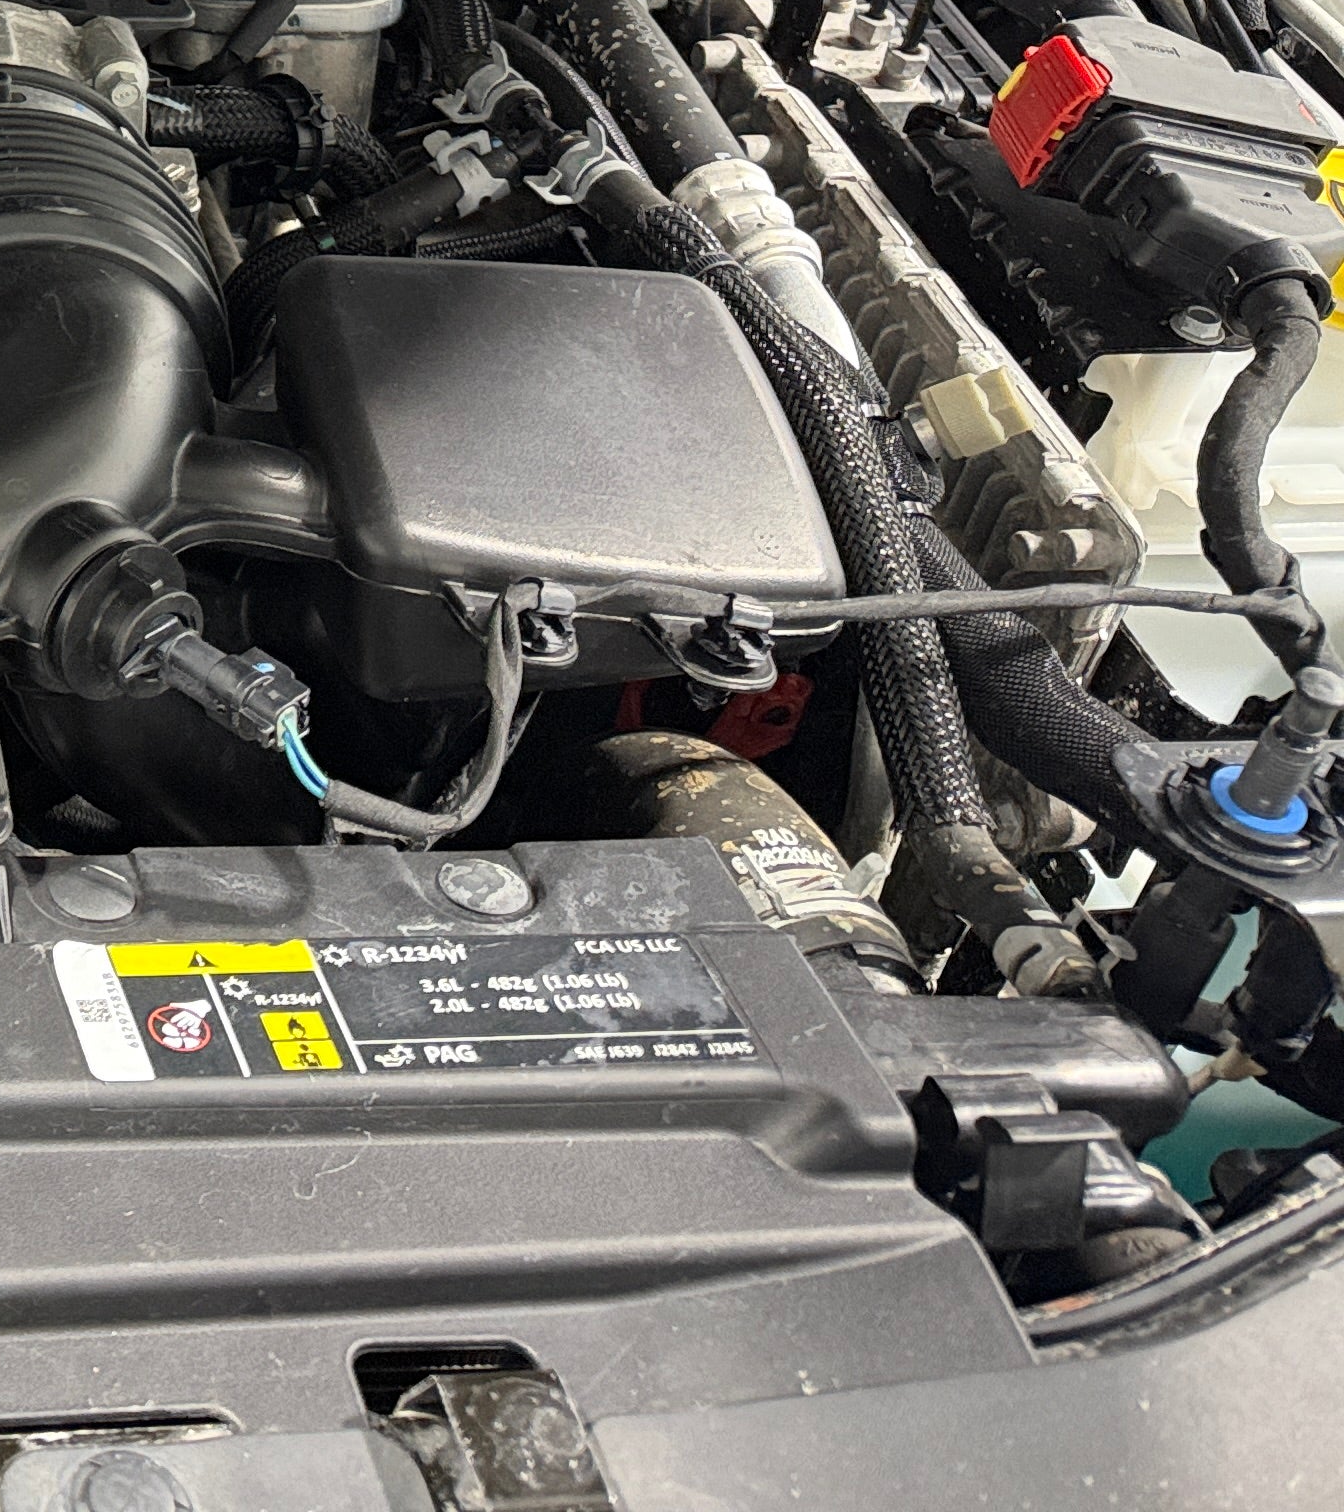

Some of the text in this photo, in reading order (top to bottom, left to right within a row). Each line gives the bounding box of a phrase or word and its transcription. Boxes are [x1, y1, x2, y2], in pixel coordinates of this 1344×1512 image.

[752, 827, 799, 847] RAD
[362, 943, 468, 964] R-1234yf
[574, 938, 682, 955] FCA US LLC
[419, 977, 464, 993] 3.6L
[488, 976, 539, 993] 482g
[542, 973, 594, 992] (1.06
[594, 971, 630, 990] Lb)
[429, 997, 475, 1014] 2.0L
[498, 996, 549, 1013] 482g
[553, 993, 605, 1012] (1.06
[605, 992, 641, 1011] Lb)
[423, 1044, 478, 1064] PAG
[573, 1045, 607, 1060] SAE
